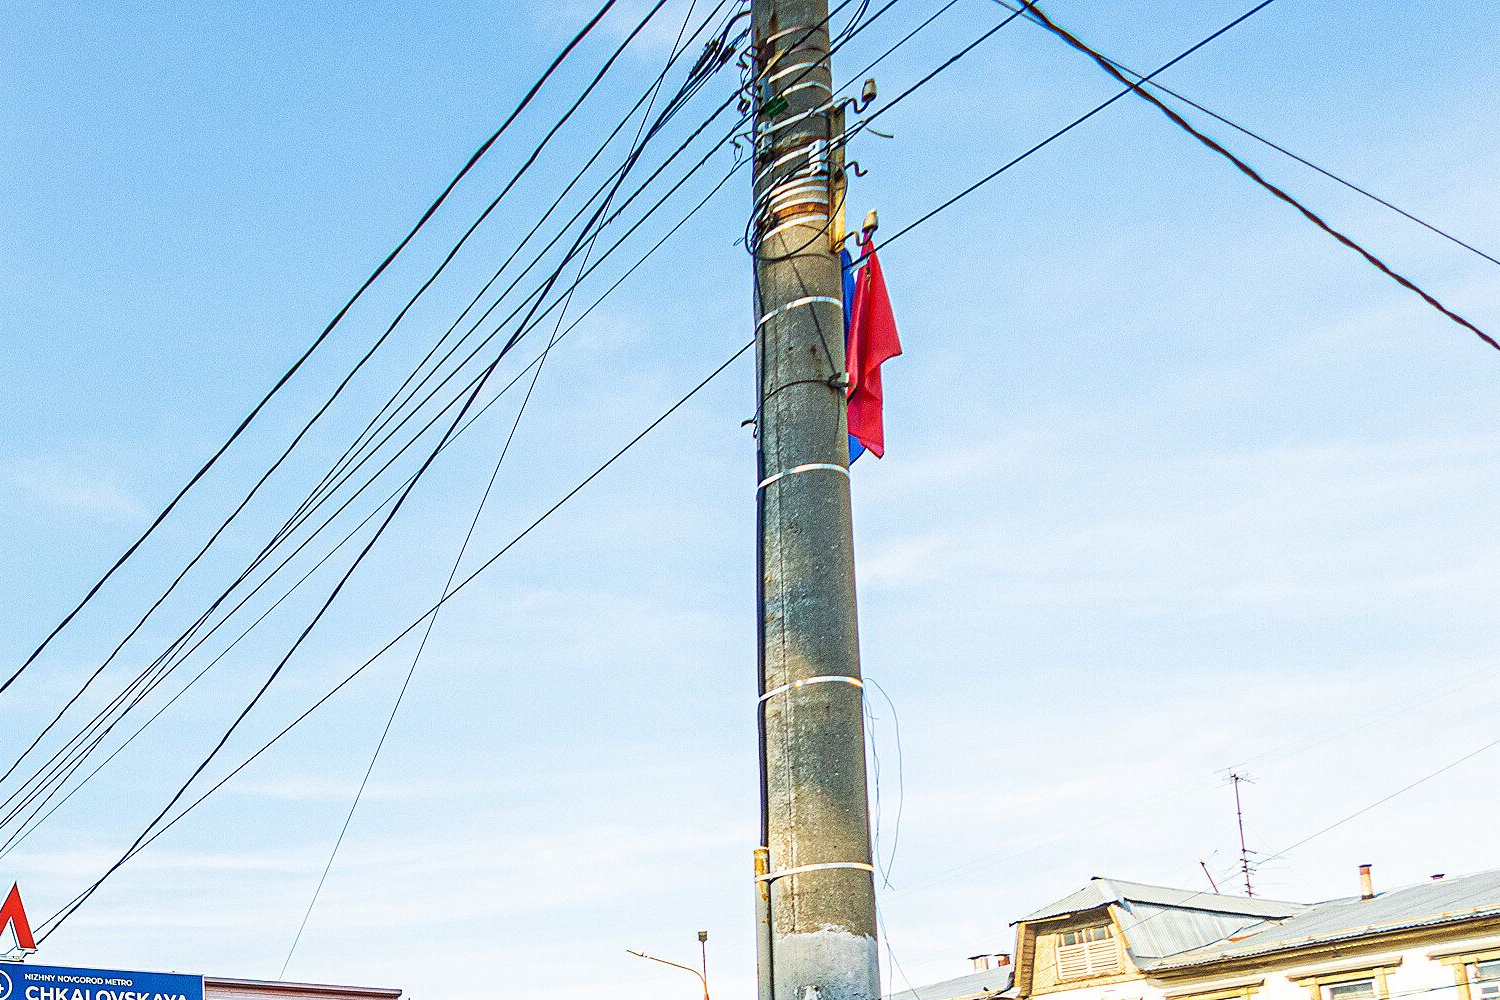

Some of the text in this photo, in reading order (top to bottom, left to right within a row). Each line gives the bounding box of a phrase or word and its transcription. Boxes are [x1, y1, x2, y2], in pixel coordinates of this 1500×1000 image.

[24, 973, 133, 987] NIZHNY NOVGOROD METRO
